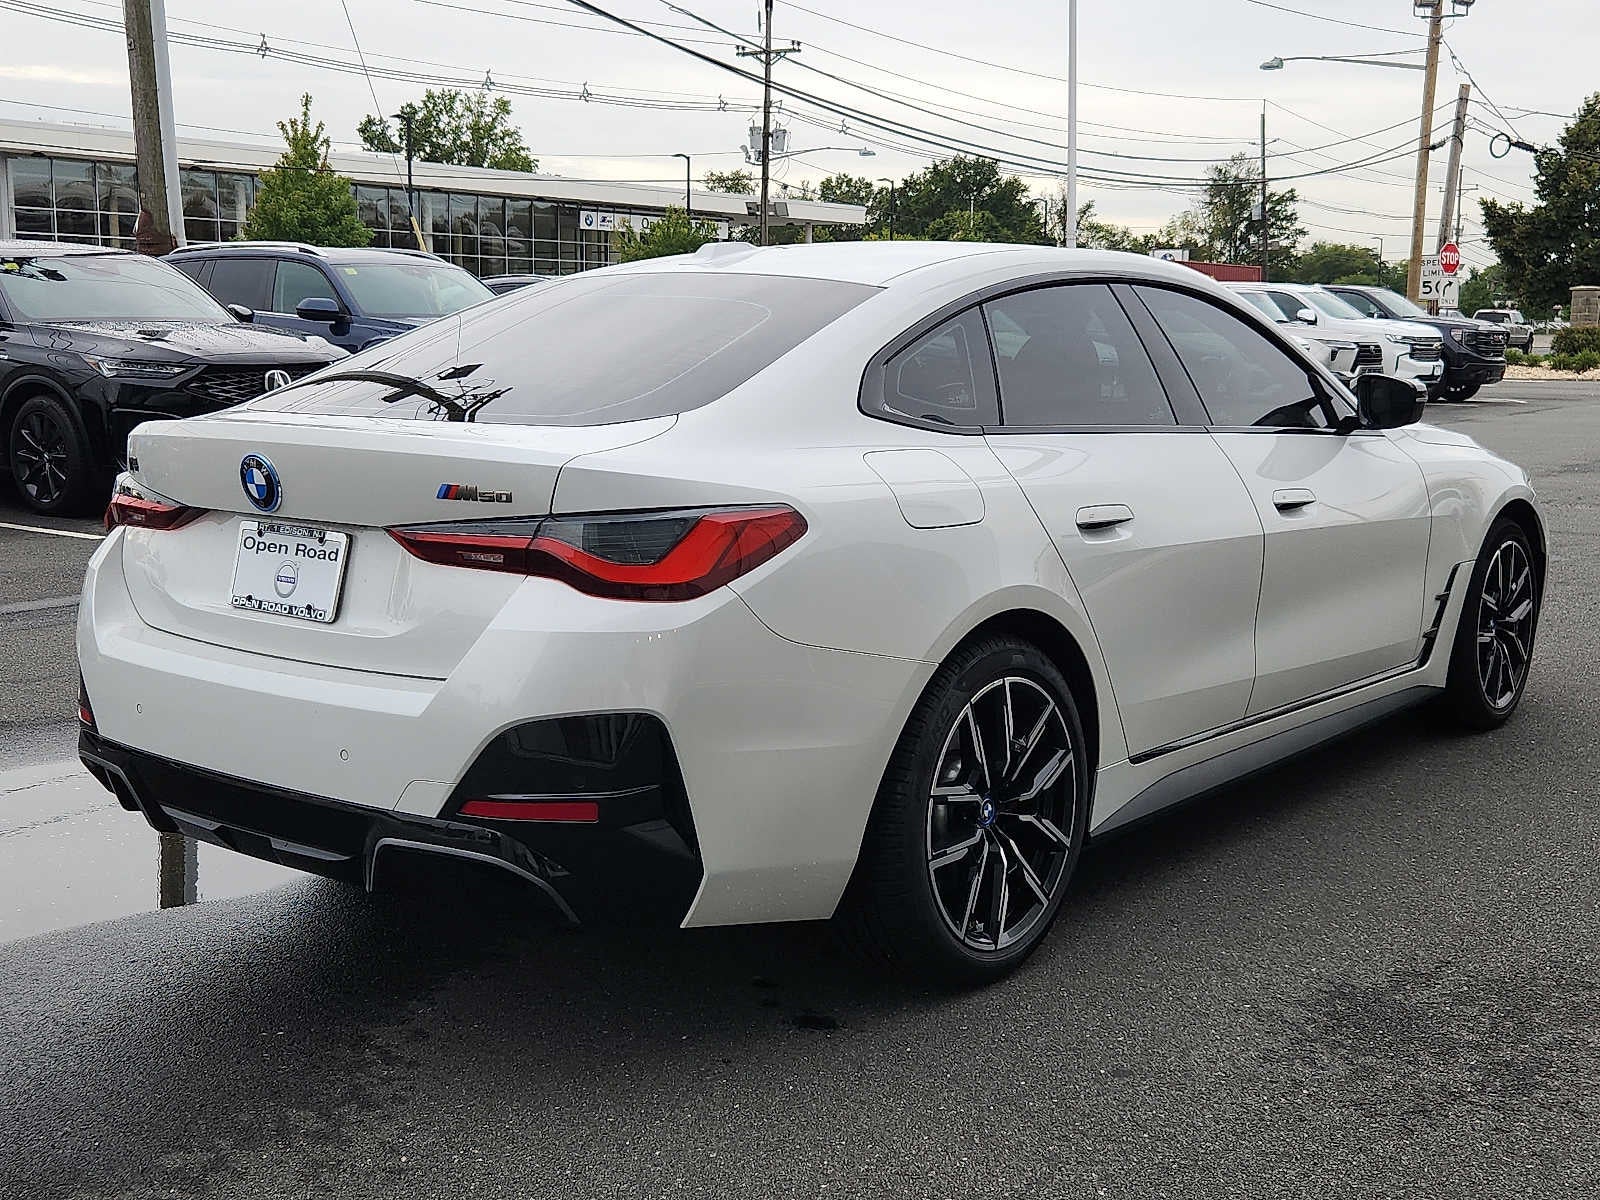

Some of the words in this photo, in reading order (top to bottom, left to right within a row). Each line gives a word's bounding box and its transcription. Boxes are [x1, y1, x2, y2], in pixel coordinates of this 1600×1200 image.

[1441, 252, 1459, 265] STOP
[456, 484, 513, 504] M50
[243, 536, 289, 555] Open
[295, 543, 339, 562] Road
[232, 596, 259, 608] OPEN
[261, 602, 289, 614] ROAD
[292, 606, 325, 619] VOLVO
